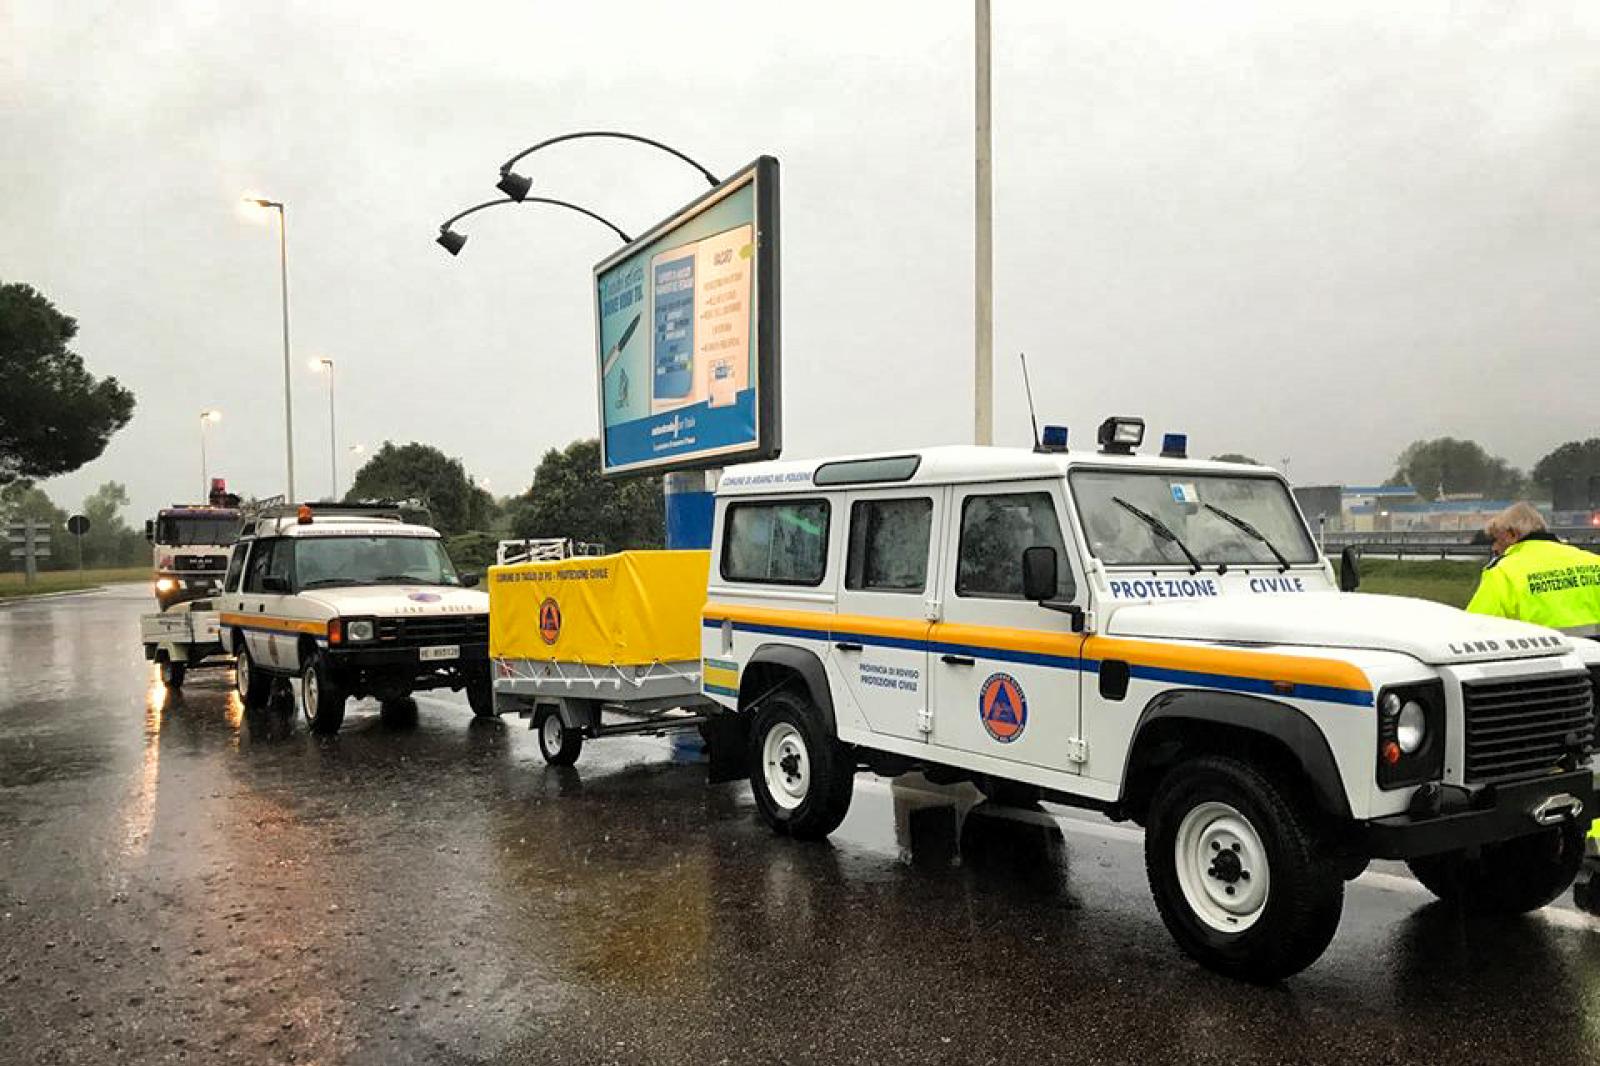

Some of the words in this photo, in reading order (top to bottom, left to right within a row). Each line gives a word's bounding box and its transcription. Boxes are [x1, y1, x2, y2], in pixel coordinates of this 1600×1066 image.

[1109, 579, 1218, 598] PROTEZIONE
[1250, 577, 1305, 593] CIVILE
[1529, 577, 1579, 595] PROTEZIONE
[1449, 640, 1500, 655] LAND
[1505, 636, 1561, 651] ROVER
[859, 663, 887, 674] PROVINCIA
[888, 666, 895, 675] DI
[896, 668, 919, 679] ROVIGO
[861, 674, 898, 689] PROTEZIONE
[898, 679, 918, 691] CIVILE
